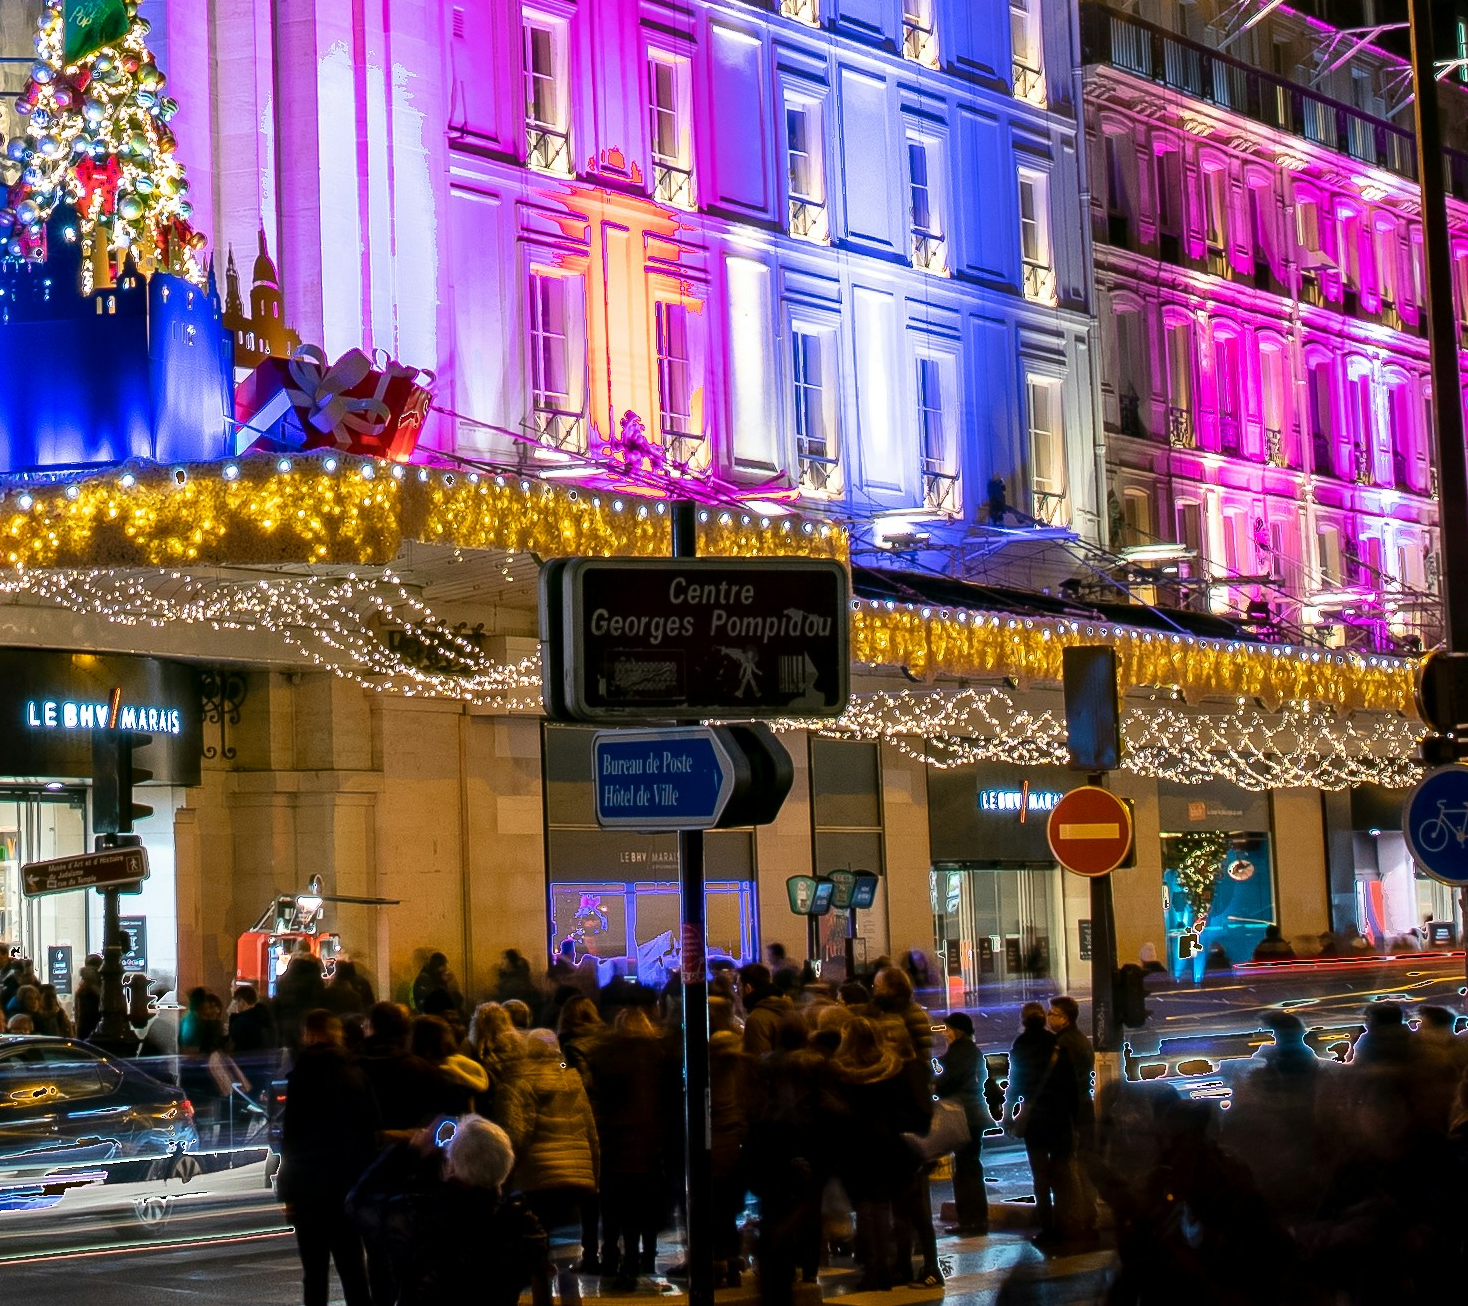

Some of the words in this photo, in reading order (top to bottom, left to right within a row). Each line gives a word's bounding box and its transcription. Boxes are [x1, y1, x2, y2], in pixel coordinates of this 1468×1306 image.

[669, 576, 755, 606] Centre
[590, 607, 695, 645] Georges
[710, 608, 832, 644] Pompidou
[28, 701, 58, 727] LE
[62, 701, 109, 729] BHV
[120, 706, 180, 734] MARAIS
[603, 754, 643, 775] Bureau
[646, 752, 660, 774] de
[663, 751, 693, 774] Poste
[604, 784, 634, 807] Hôtel
[637, 785, 651, 806] de
[654, 784, 679, 806] Ville
[620, 852, 629, 863] LE
[631, 852, 647, 863] BHV
